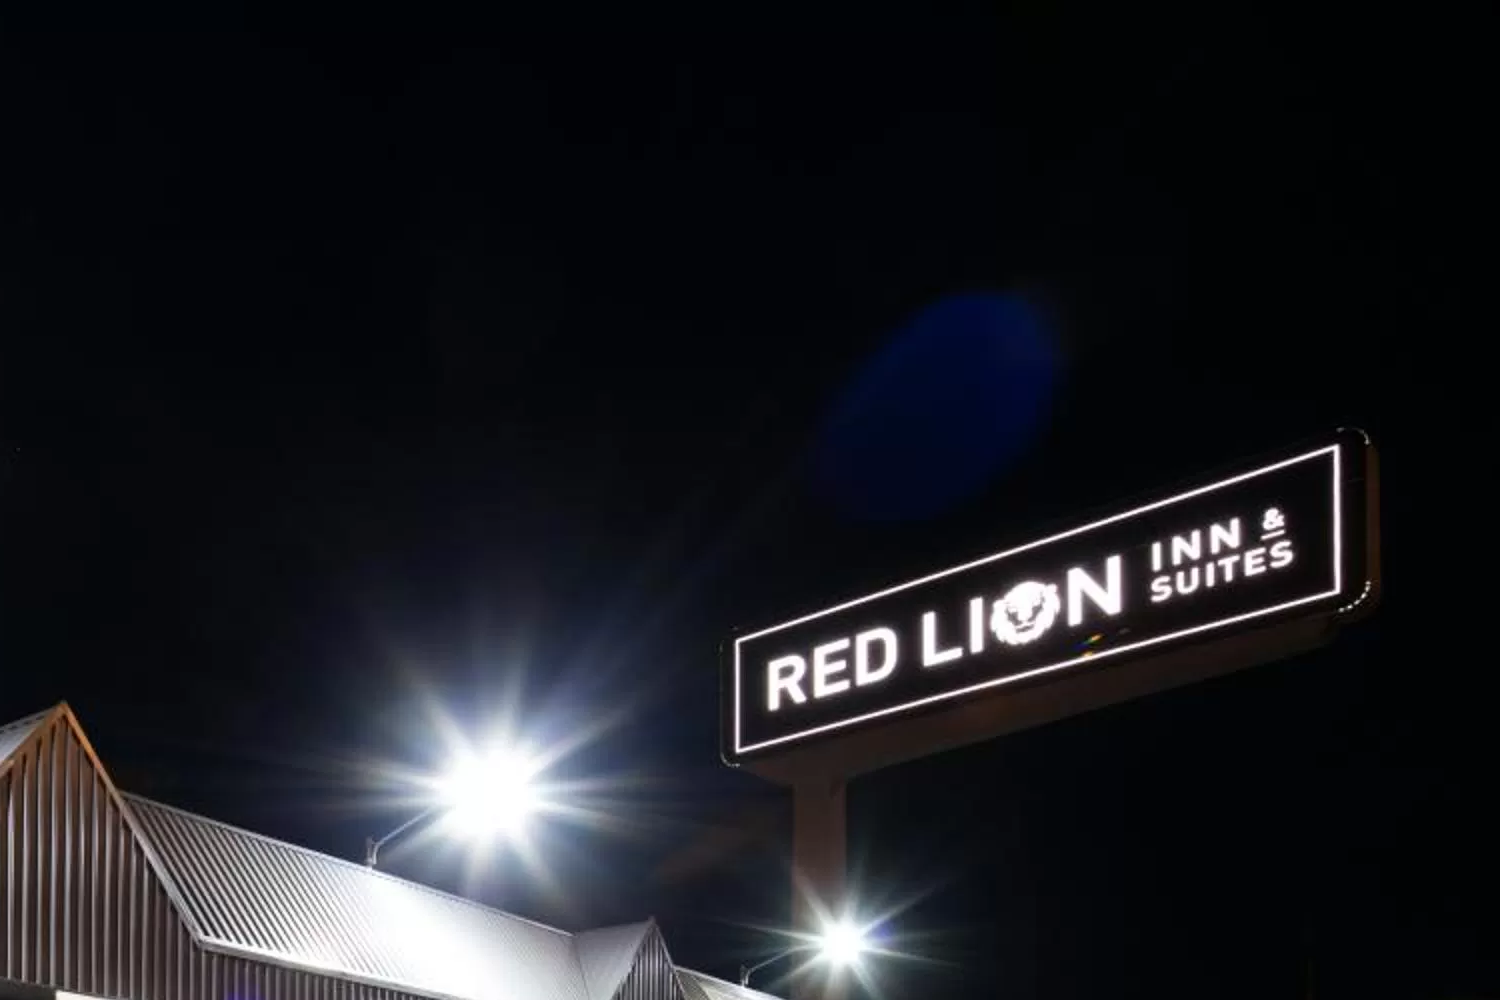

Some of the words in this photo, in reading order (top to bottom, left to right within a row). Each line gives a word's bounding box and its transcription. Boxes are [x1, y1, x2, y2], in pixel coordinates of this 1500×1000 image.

[1150, 539, 1294, 603] SUITES
[1151, 517, 1241, 572] INN
[1261, 507, 1286, 534] &
[766, 626, 899, 712] RED
